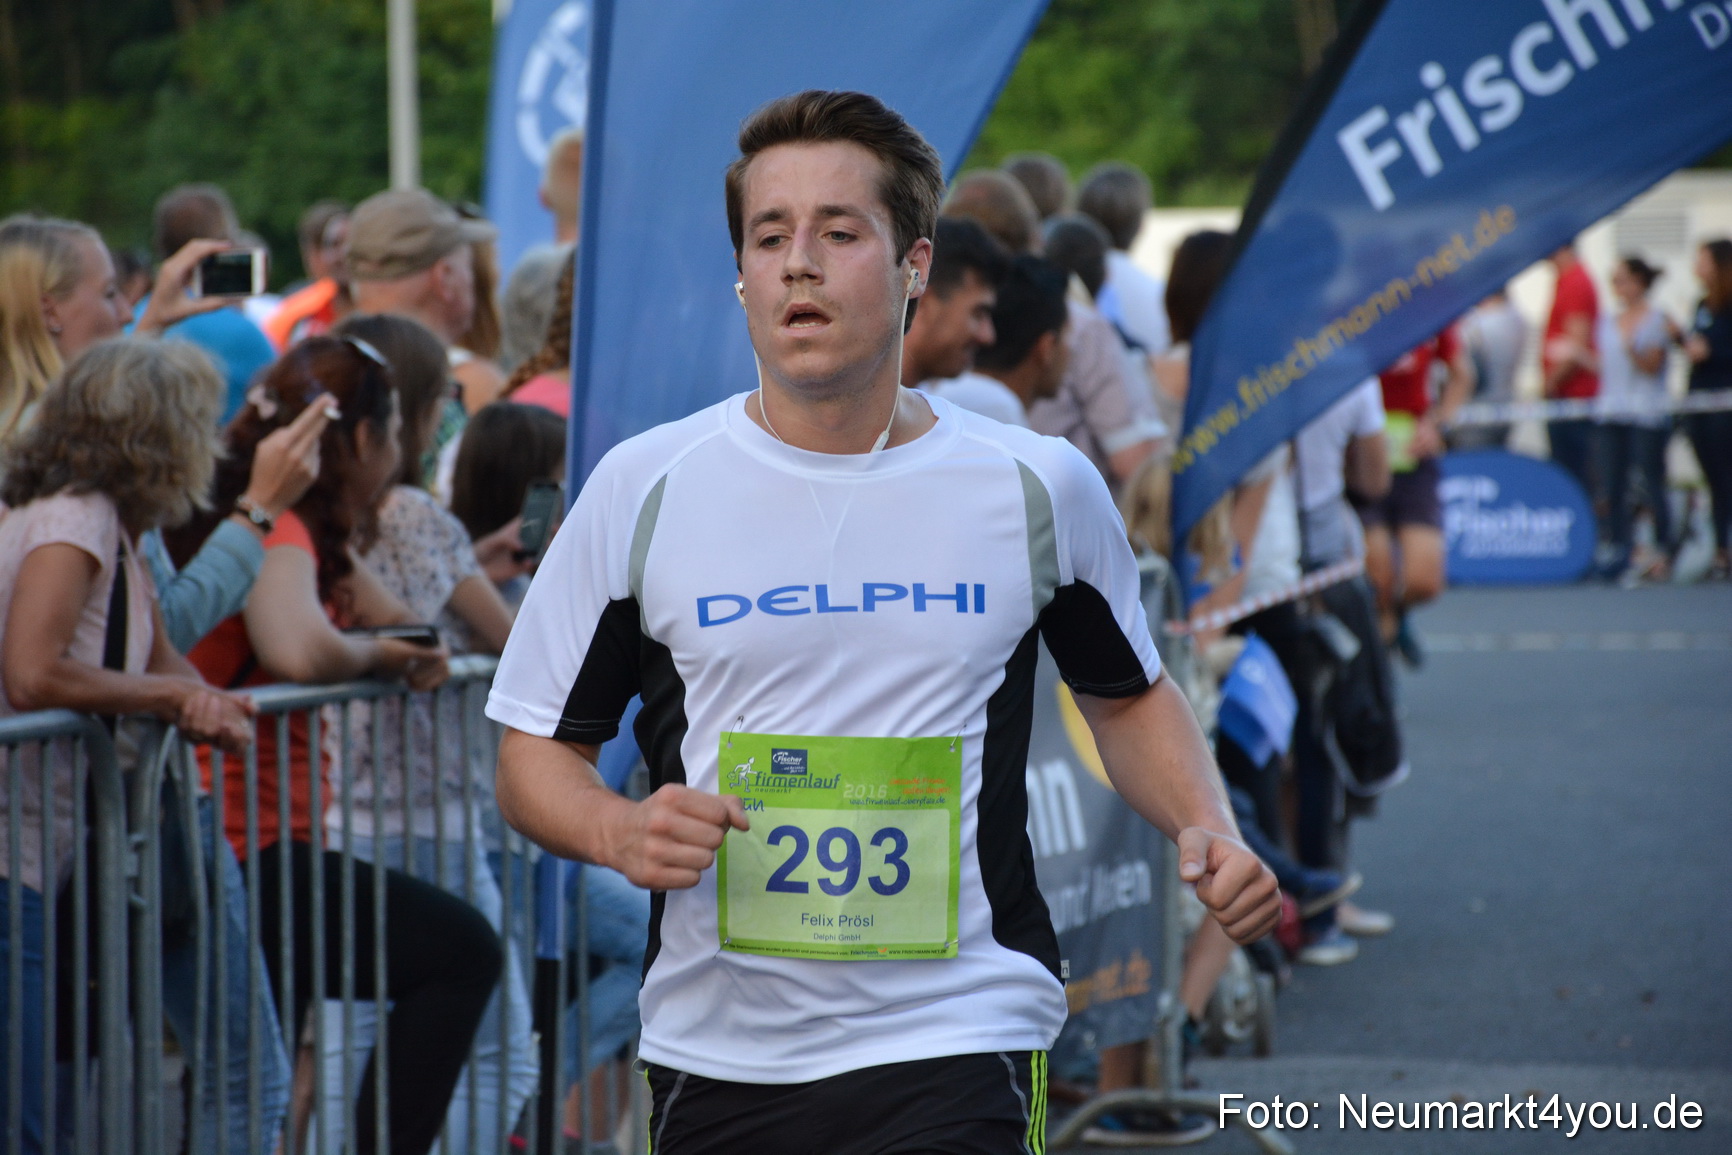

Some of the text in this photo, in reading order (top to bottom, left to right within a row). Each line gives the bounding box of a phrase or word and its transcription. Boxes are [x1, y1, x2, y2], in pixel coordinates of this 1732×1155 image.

[697, 583, 985, 628] DELPHI
[775, 752, 802, 763] Fischer
[755, 771, 841, 789] firmenlauf
[843, 784, 888, 798] 2016
[765, 825, 911, 896] 293
[801, 912, 874, 928] Felix Prösl
[813, 932, 861, 942] Delphi GmbH
